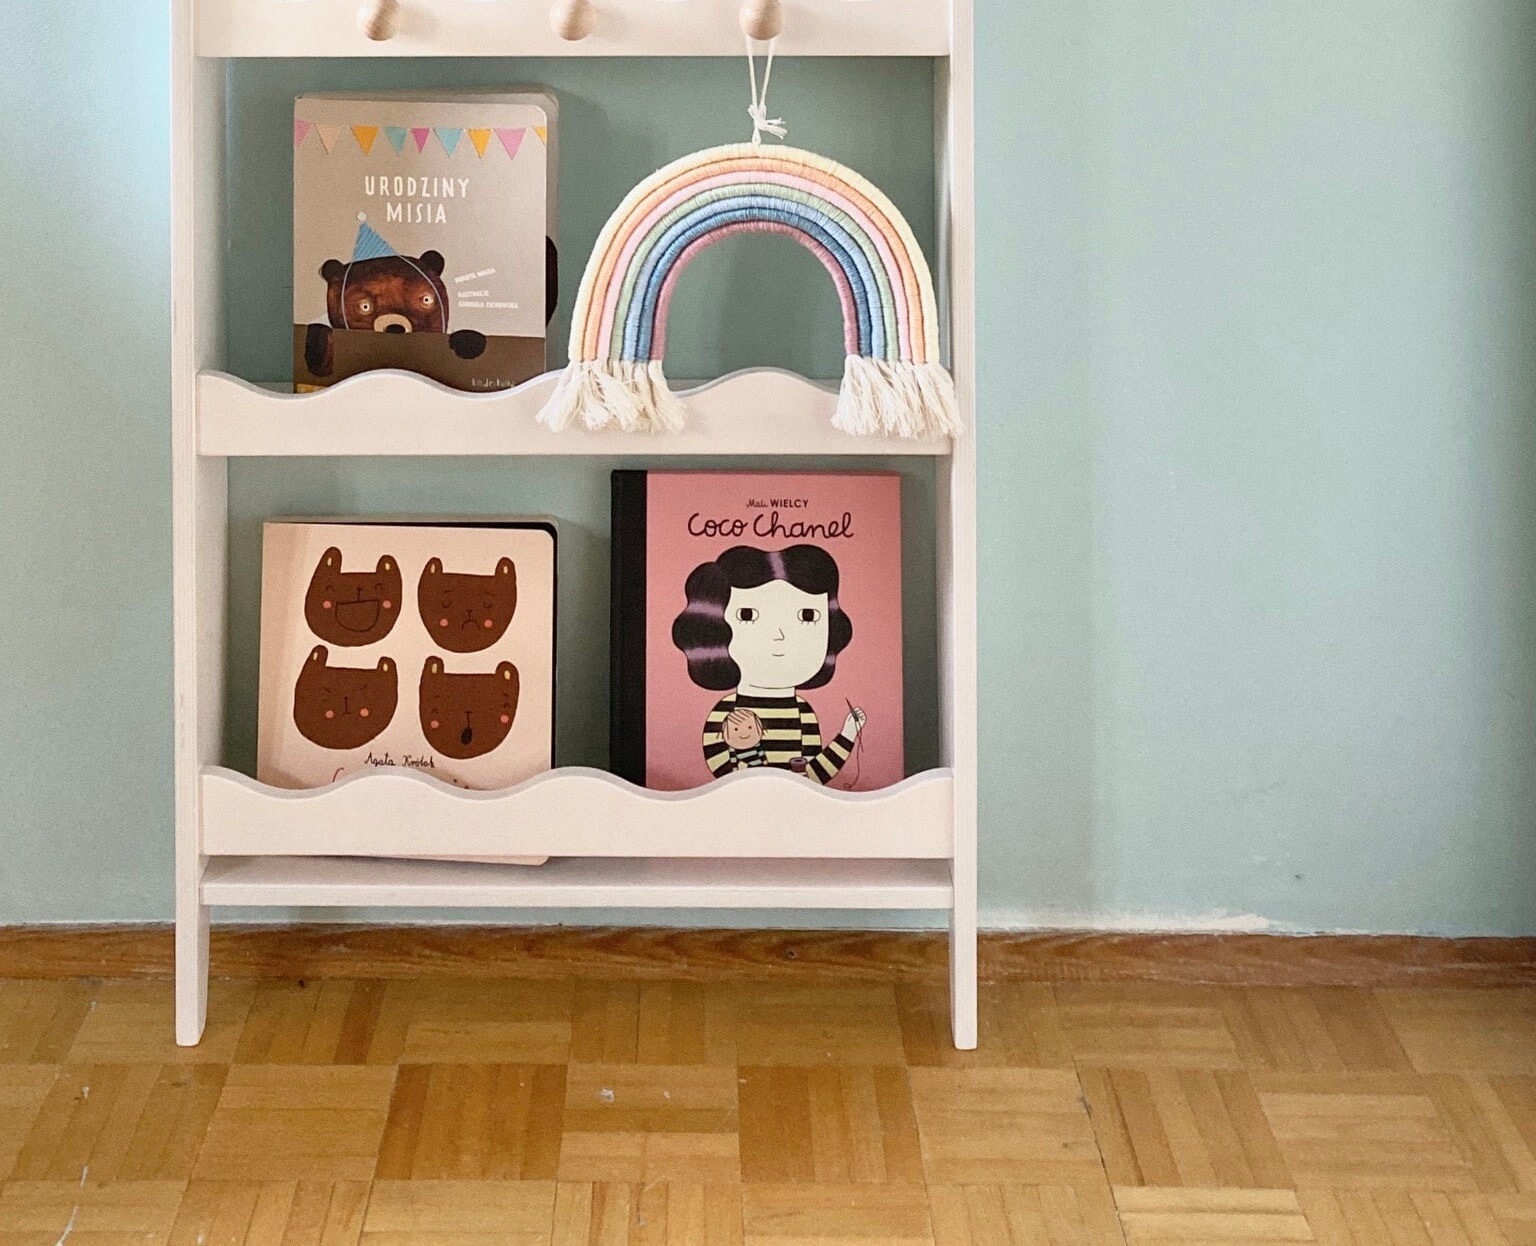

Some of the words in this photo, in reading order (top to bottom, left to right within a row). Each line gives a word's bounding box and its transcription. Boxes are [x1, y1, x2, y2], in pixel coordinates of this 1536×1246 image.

[365, 175, 470, 198] URODZINY
[386, 202, 447, 224] MISIA
[770, 499, 809, 508] WIELCY
[688, 513, 749, 537] Coco
[753, 511, 854, 539] Chanel
[365, 752, 396, 767] Agata
